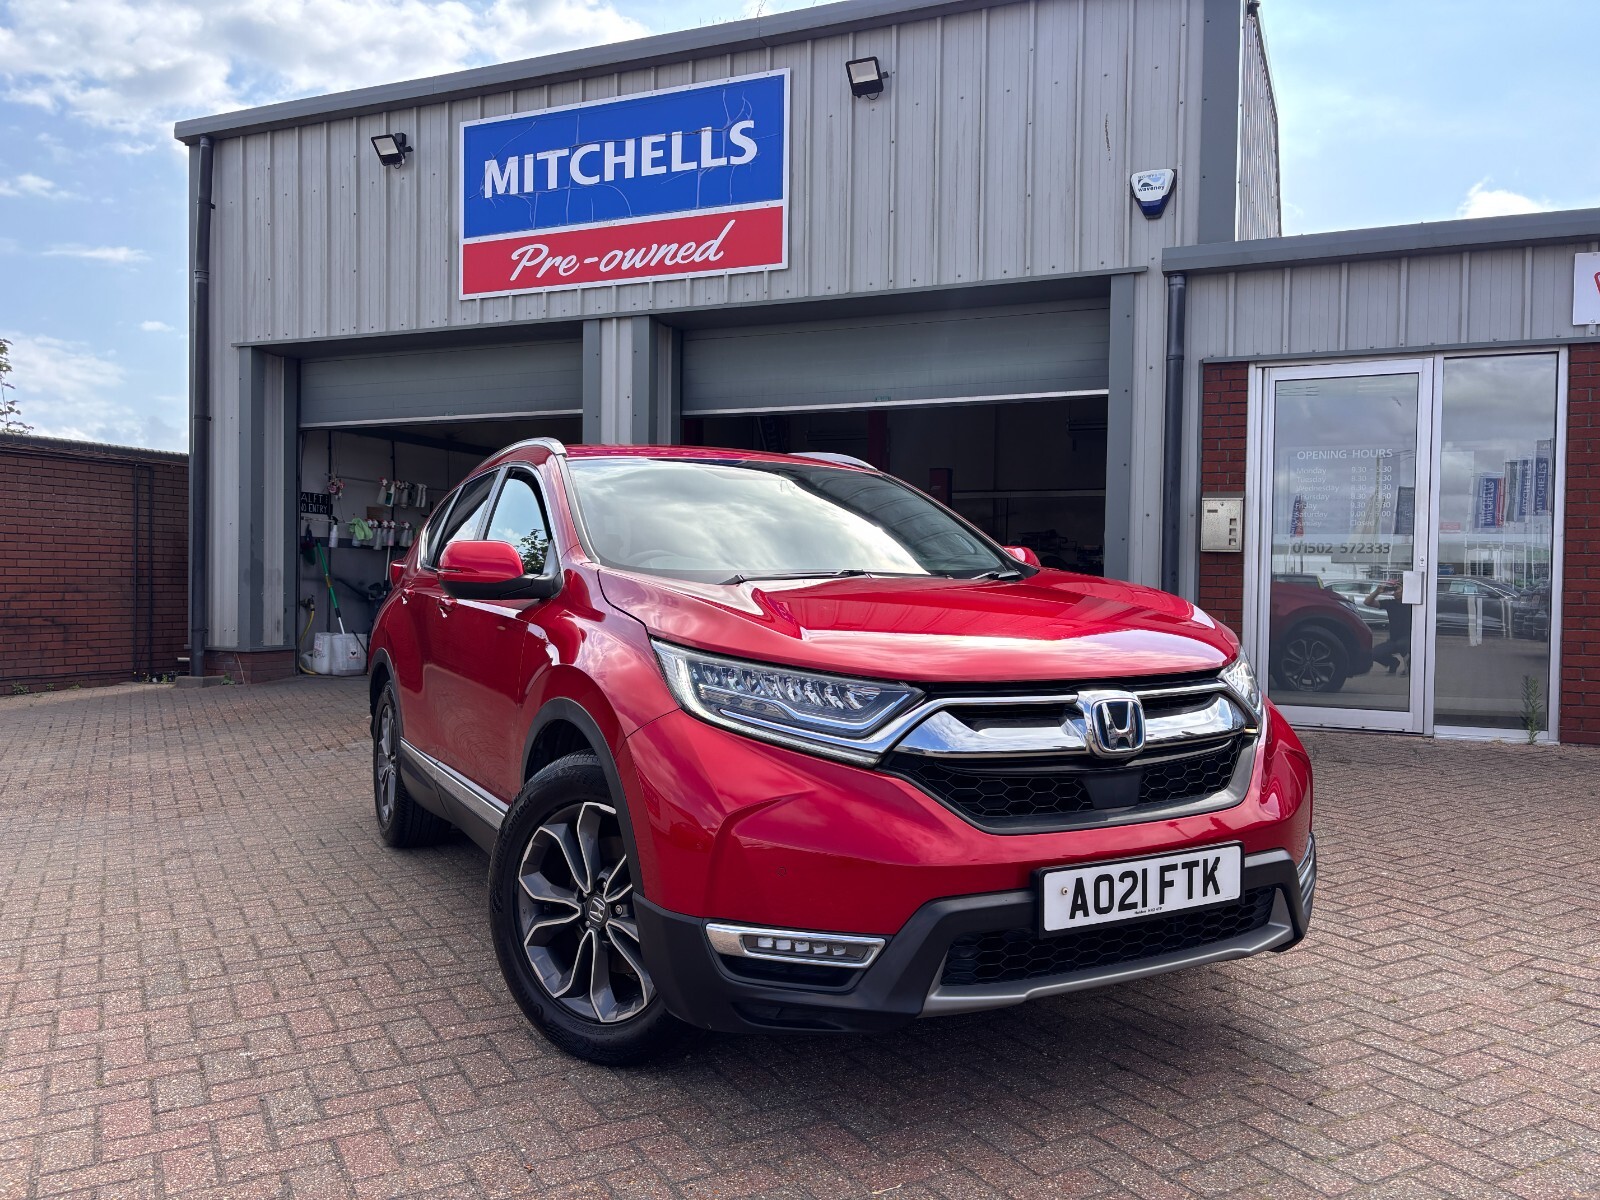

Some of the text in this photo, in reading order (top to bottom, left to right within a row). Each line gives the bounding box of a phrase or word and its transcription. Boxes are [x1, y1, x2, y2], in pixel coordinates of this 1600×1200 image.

[484, 120, 758, 198] MITCHELLS
[510, 219, 736, 281] Pre-owned
[1297, 448, 1393, 460] OPENING HOURS
[1296, 467, 1327, 475] Monday
[1297, 476, 1327, 484] Tuesday
[1296, 485, 1340, 493] Wednesday
[1536, 463, 1547, 513] MITCHELLS
[1292, 542, 1391, 554] 01502 572333
[1159, 856, 1221, 905] FTK
